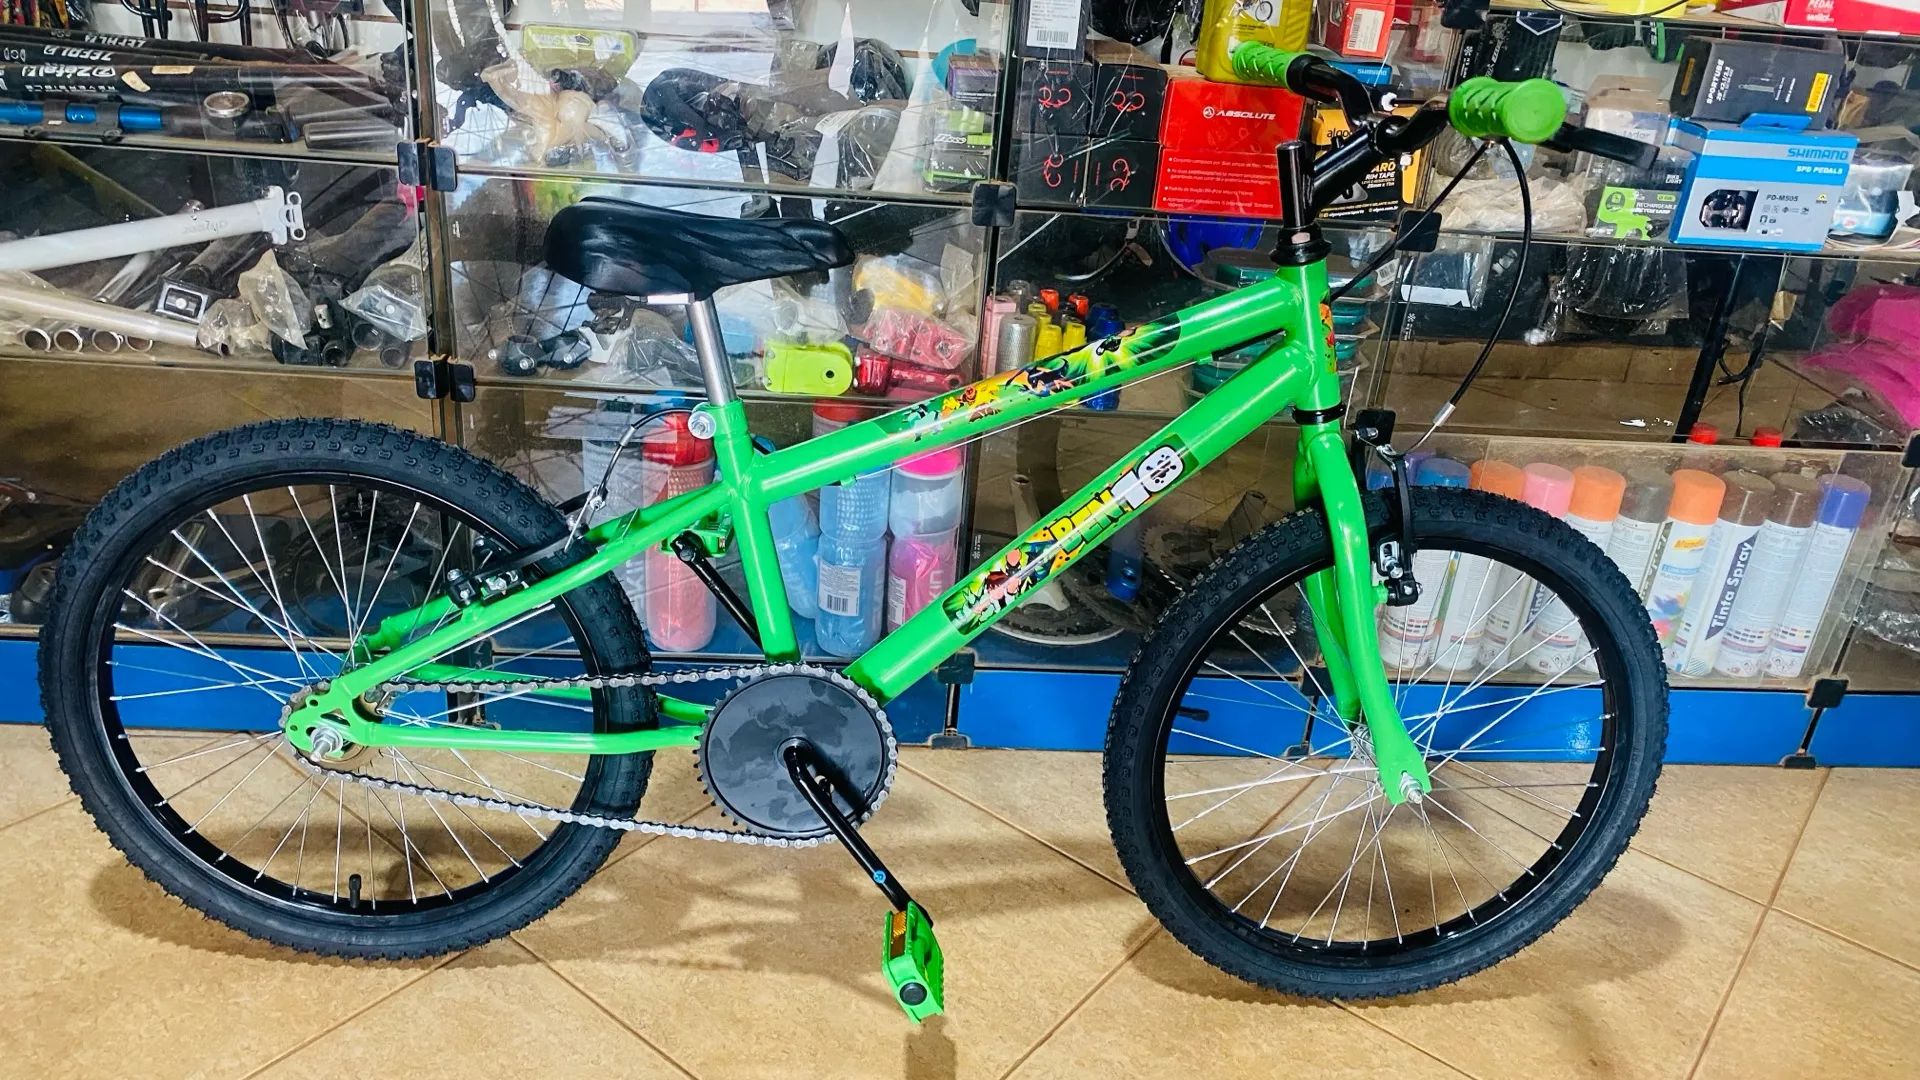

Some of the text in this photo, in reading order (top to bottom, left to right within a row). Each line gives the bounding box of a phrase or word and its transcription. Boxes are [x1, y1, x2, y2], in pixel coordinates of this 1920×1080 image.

[1705, 59, 1725, 105] SPORTUBE
[1216, 110, 1276, 120] ABSOLUTE
[1787, 147, 1849, 161] SHIMANO
[1813, 166, 1843, 175] PEDALS
[1766, 194, 1799, 202] PD-M505
[1711, 542, 1755, 628] Tinta Spray
